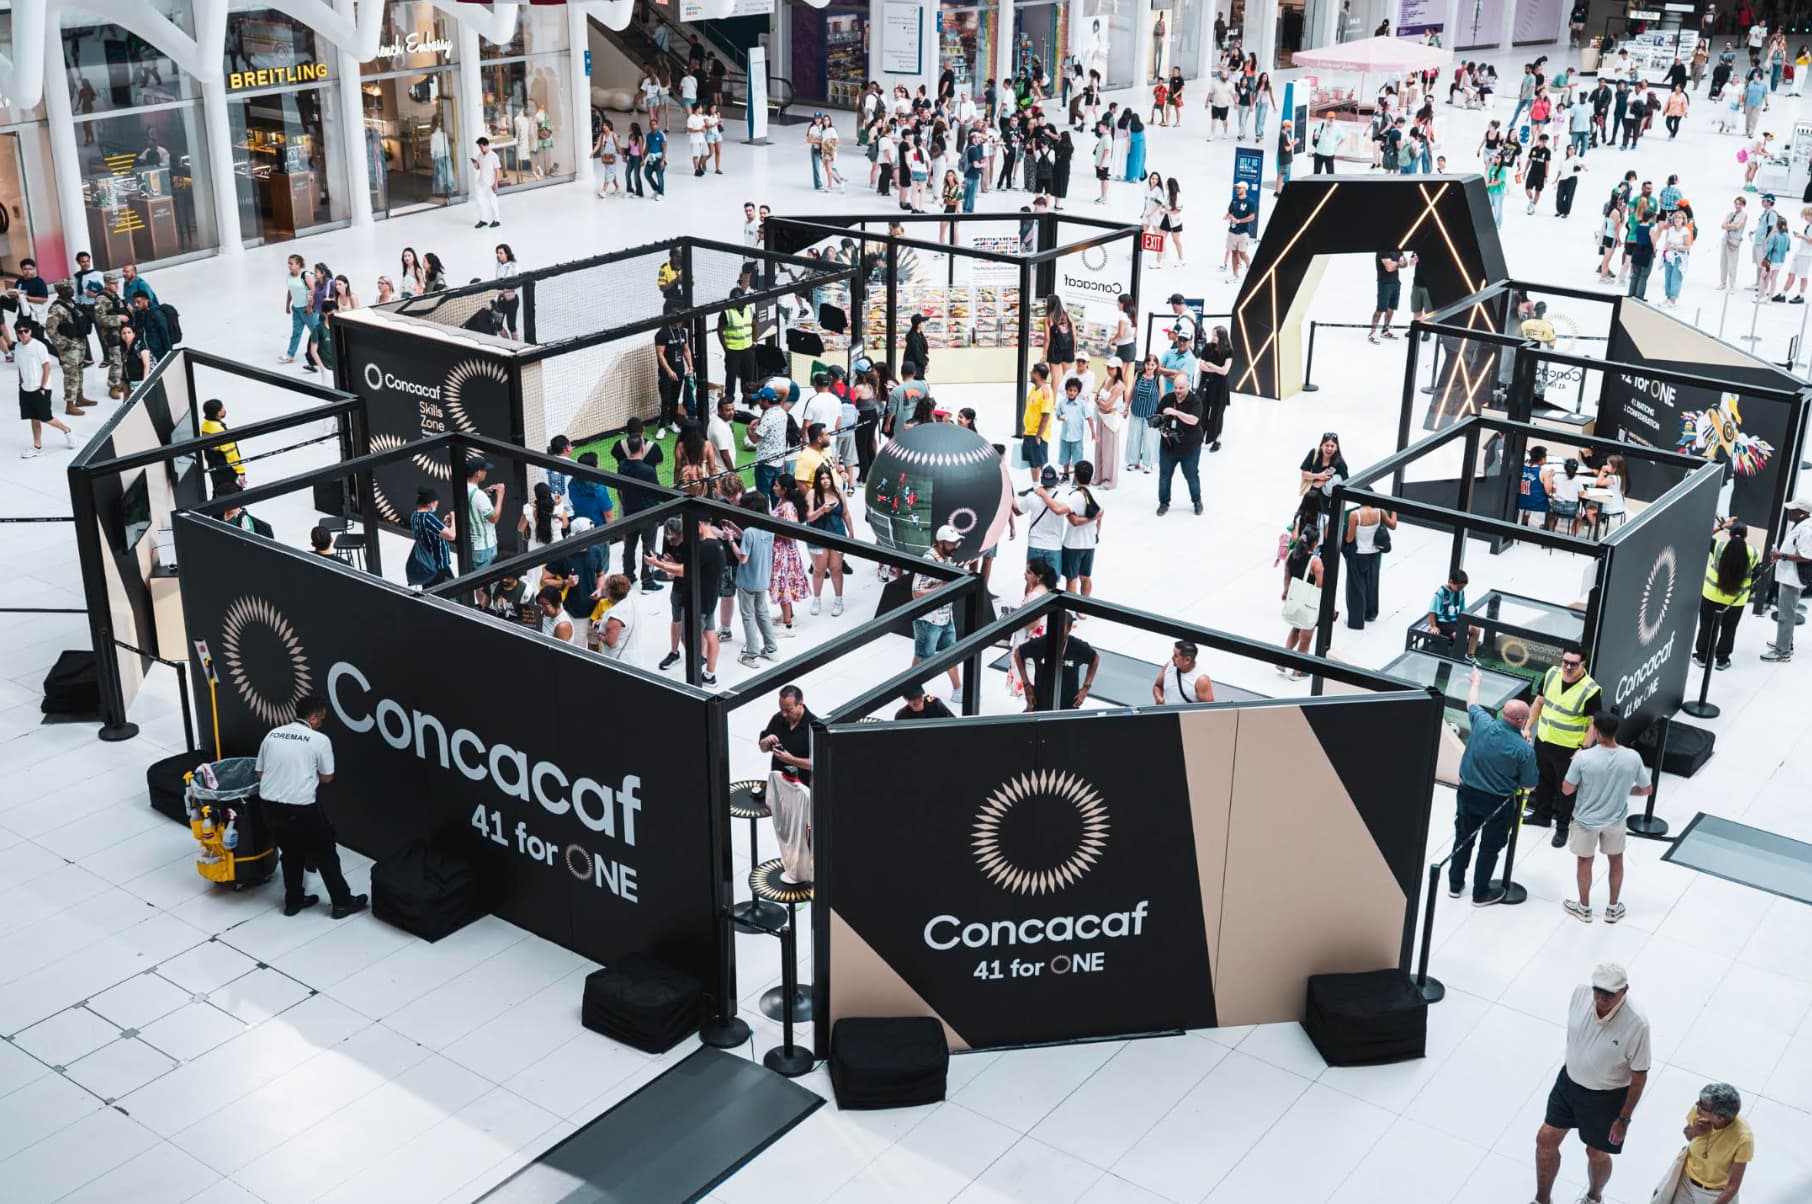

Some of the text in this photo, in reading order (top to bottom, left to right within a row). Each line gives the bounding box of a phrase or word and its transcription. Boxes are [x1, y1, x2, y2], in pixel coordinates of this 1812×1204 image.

[405, 32, 454, 59] Embassy
[230, 63, 328, 89] BREITLING
[1146, 234, 1162, 250] EXIT
[385, 373, 441, 400] Concacaf
[1651, 379, 1676, 408] ONE
[419, 401, 443, 418] Skills
[420, 414, 445, 432] Zone
[1616, 630, 1676, 704] Concacaf
[1643, 676, 1660, 701] ONE
[269, 732, 311, 742] FOREMAN
[327, 661, 642, 847] Concacaf
[471, 804, 639, 904] 41 for ONE
[923, 900, 1149, 951] Concacaf
[973, 952, 1105, 980] 41 for ONE
